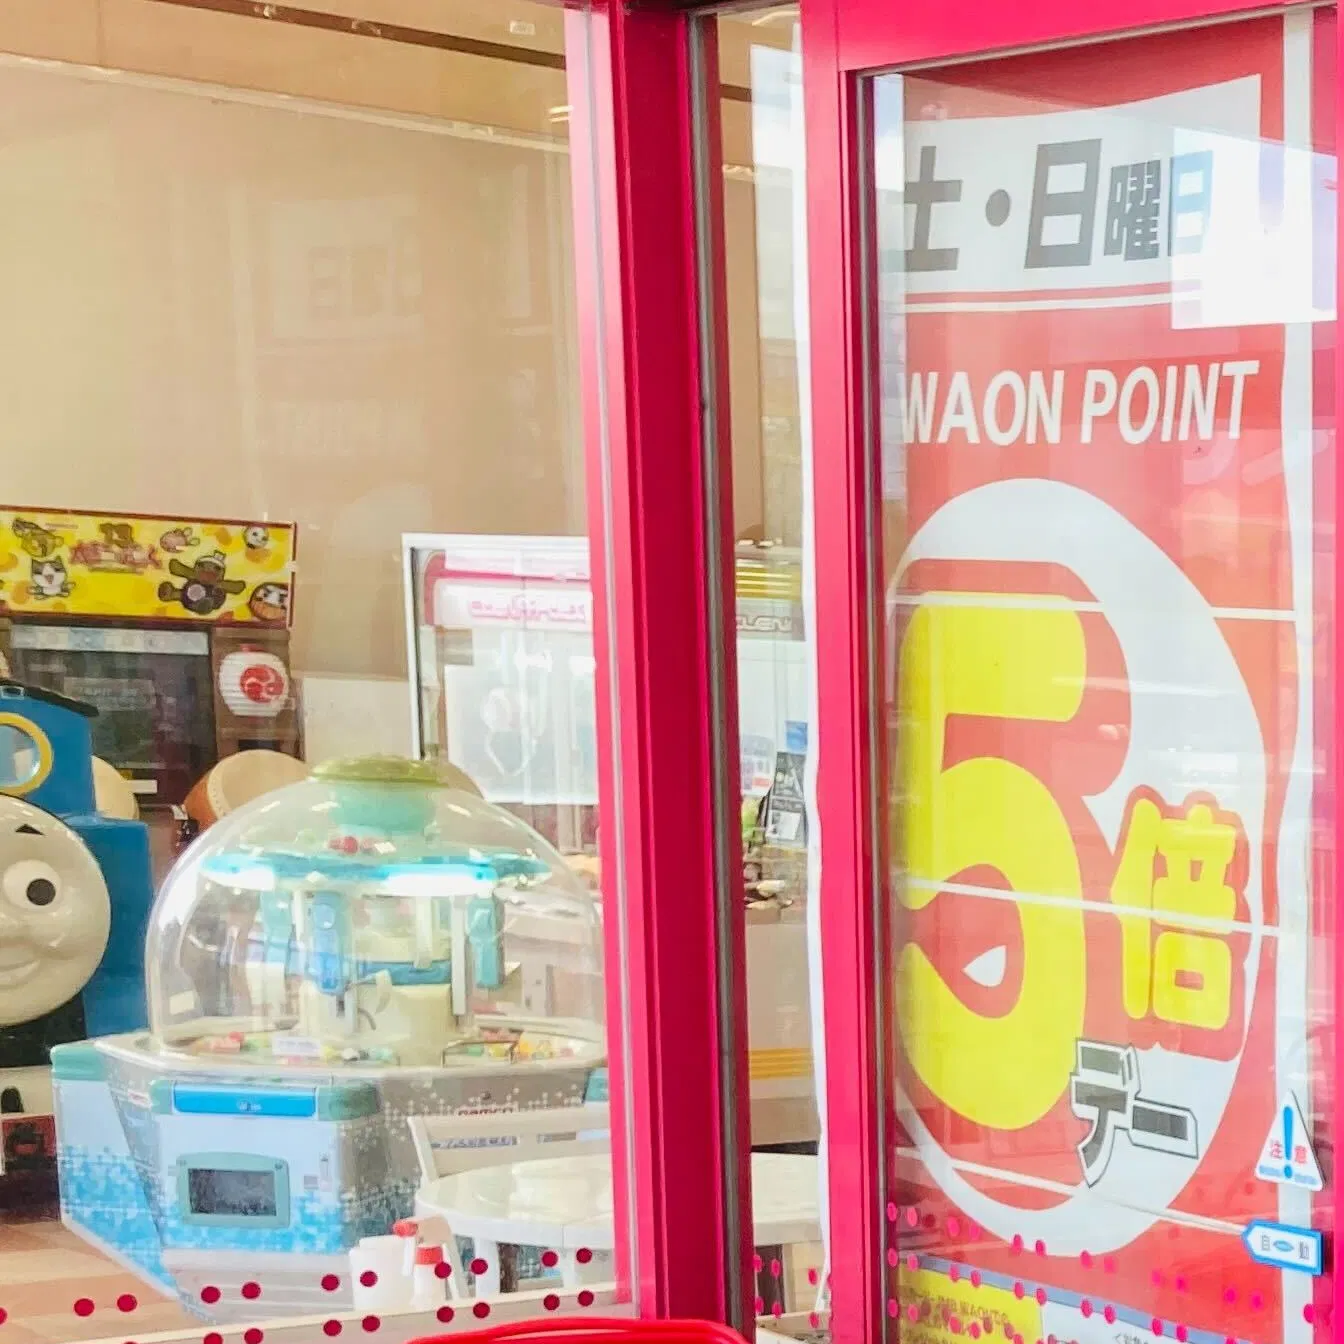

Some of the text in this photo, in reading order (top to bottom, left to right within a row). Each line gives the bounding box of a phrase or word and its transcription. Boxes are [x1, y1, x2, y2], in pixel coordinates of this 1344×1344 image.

[905, 139, 1213, 271] 土・日曜日
[902, 361, 1259, 444] WAON POINT
